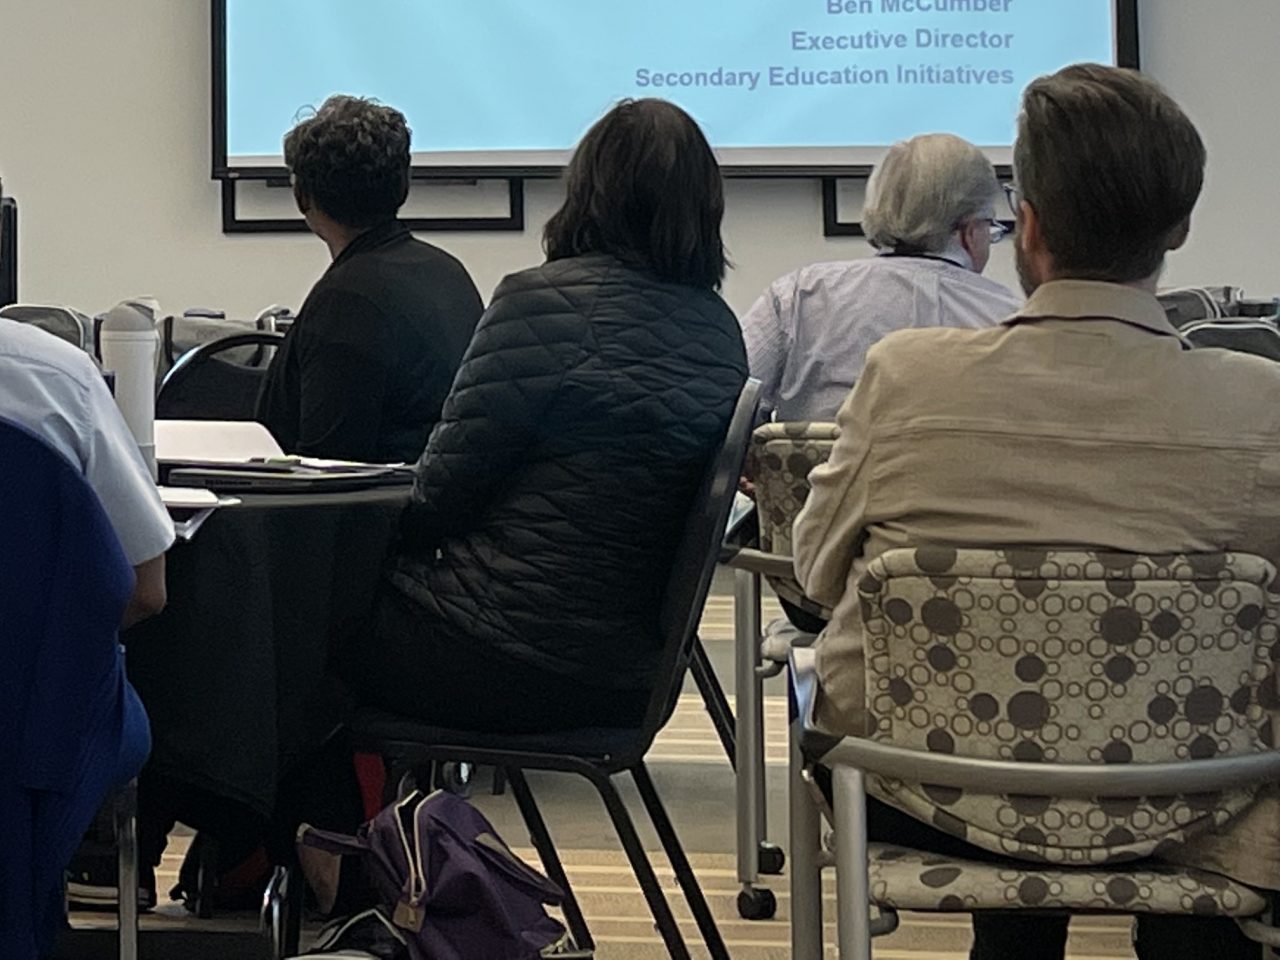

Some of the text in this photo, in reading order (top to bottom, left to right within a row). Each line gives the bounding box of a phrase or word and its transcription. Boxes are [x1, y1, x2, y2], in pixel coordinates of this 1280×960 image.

[791, 28, 1014, 50] Executive Director
[635, 64, 1014, 90] Secondary Education Initiatives
